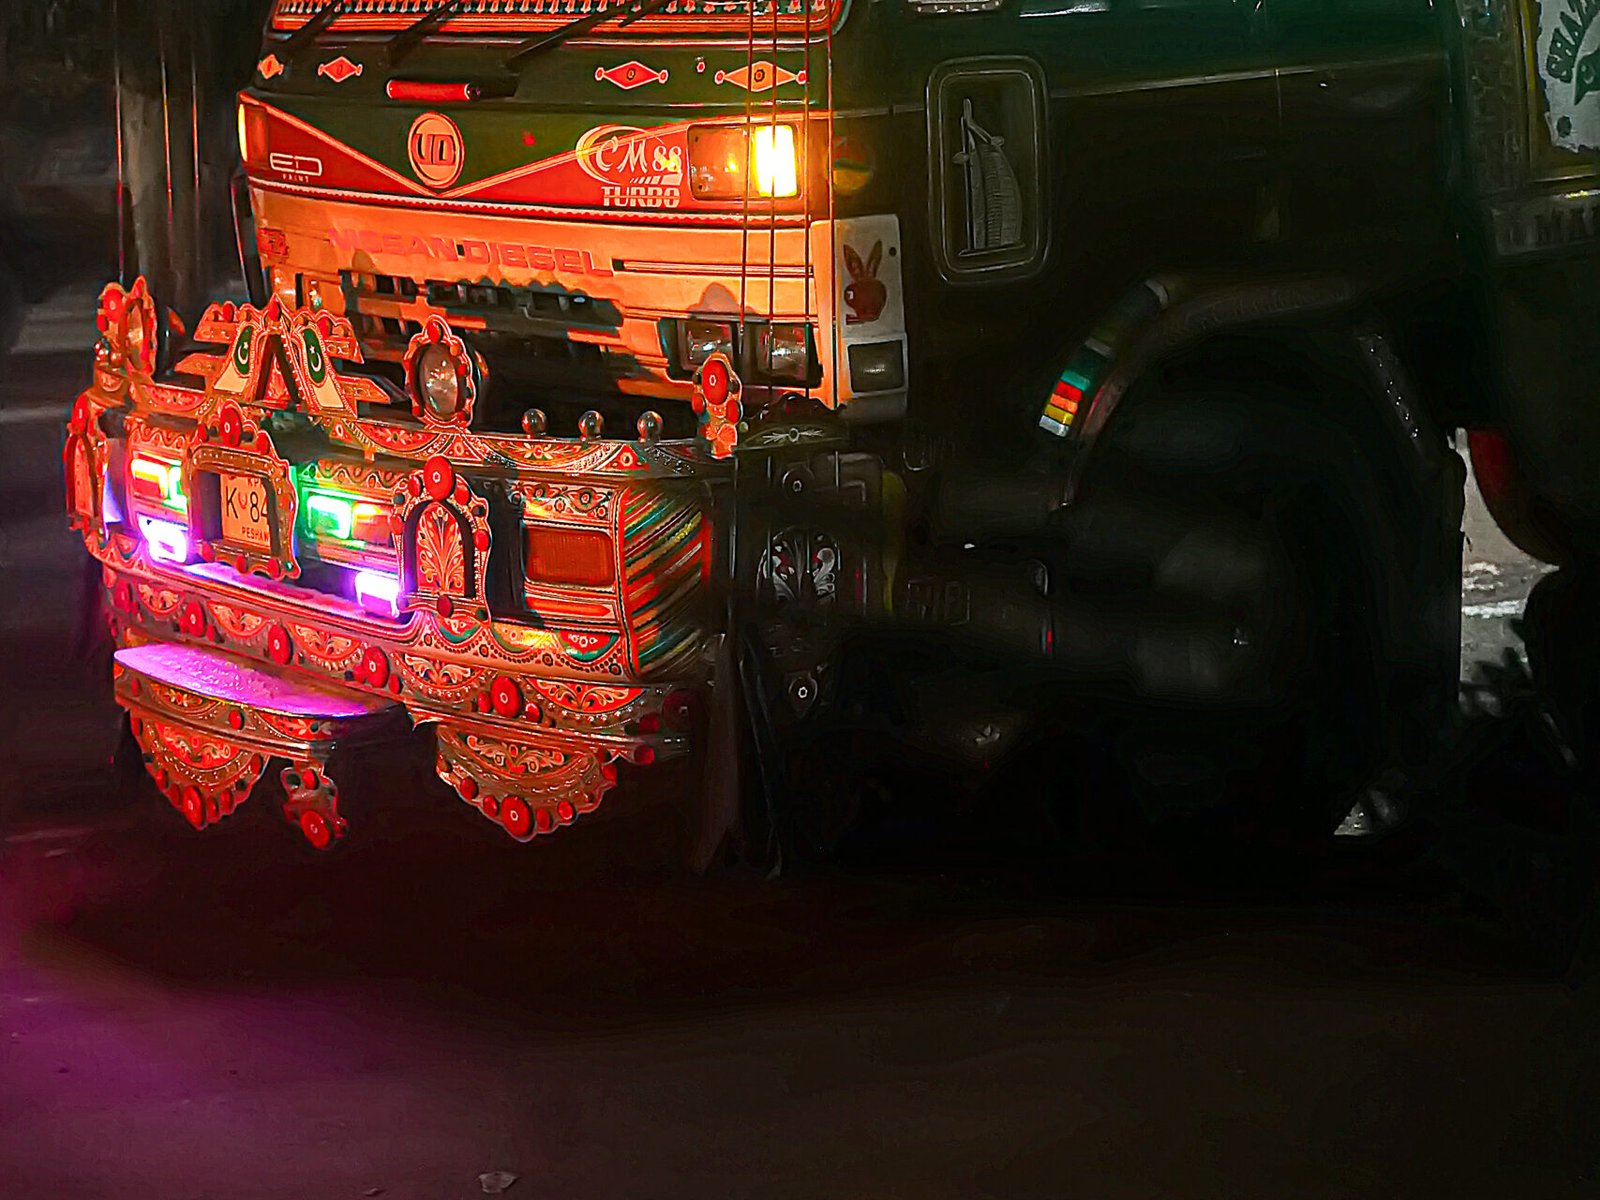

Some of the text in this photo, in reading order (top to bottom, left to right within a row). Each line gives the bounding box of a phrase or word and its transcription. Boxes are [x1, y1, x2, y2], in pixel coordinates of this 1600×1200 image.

[411, 133, 456, 166] UD
[601, 186, 681, 208] TURBO
[462, 239, 614, 277] DIESEL
